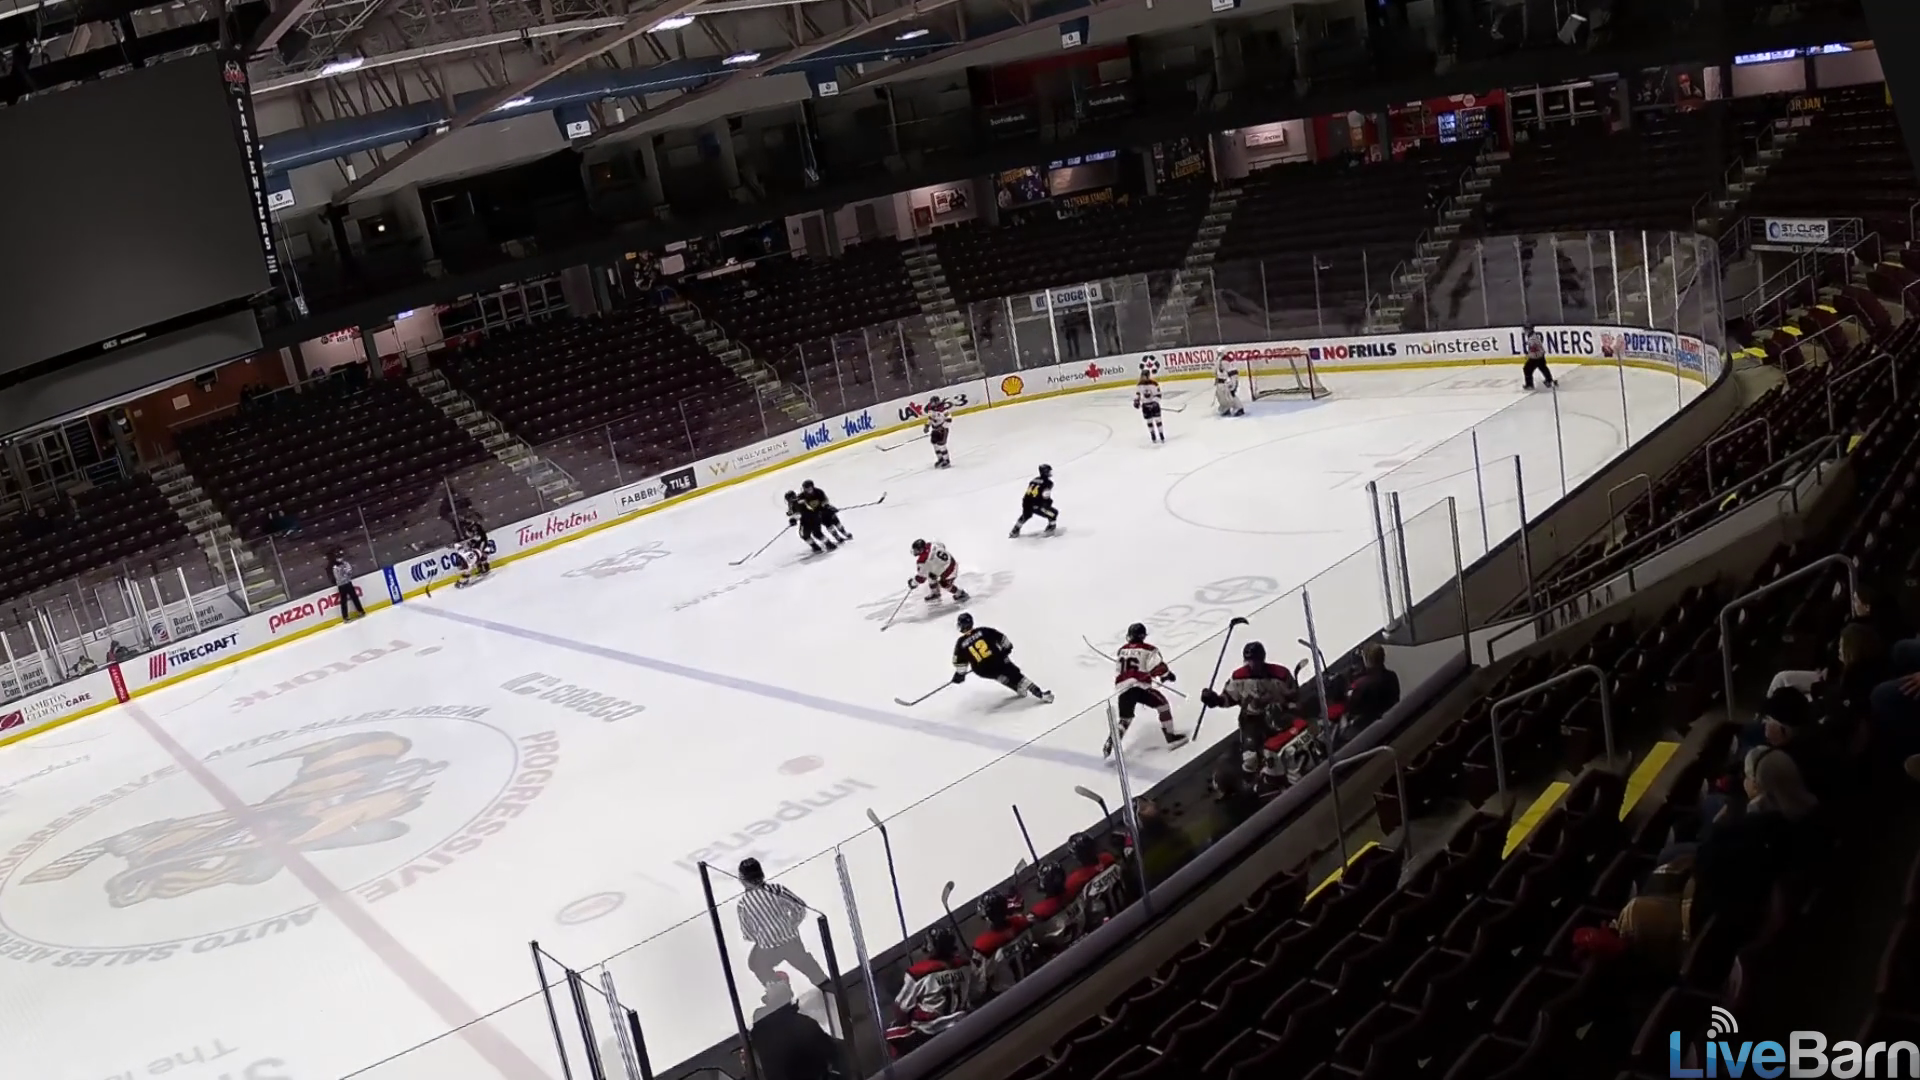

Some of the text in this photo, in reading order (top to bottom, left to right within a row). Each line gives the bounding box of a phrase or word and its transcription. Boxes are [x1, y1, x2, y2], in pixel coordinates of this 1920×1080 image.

[1056, 287, 1097, 303] COGEO
[1162, 350, 1215, 367] TRANSCO
[1405, 336, 1499, 356] mainstreet
[736, 441, 788, 462] WOLVERINE
[621, 475, 690, 506] FABBRI TILE
[515, 510, 598, 546] Tim Hortons
[269, 586, 363, 633] pizza piza
[168, 633, 238, 667] TIRECRAFT
[968, 639, 992, 663] 12
[1119, 657, 1140, 674] 16
[23, 692, 67, 714] LAMBTON
[357, 729, 561, 904] PROGRESSIVE
[191, 905, 320, 957] AUTO
[51, 943, 183, 968] SALES
[146, 1037, 241, 1076] The
